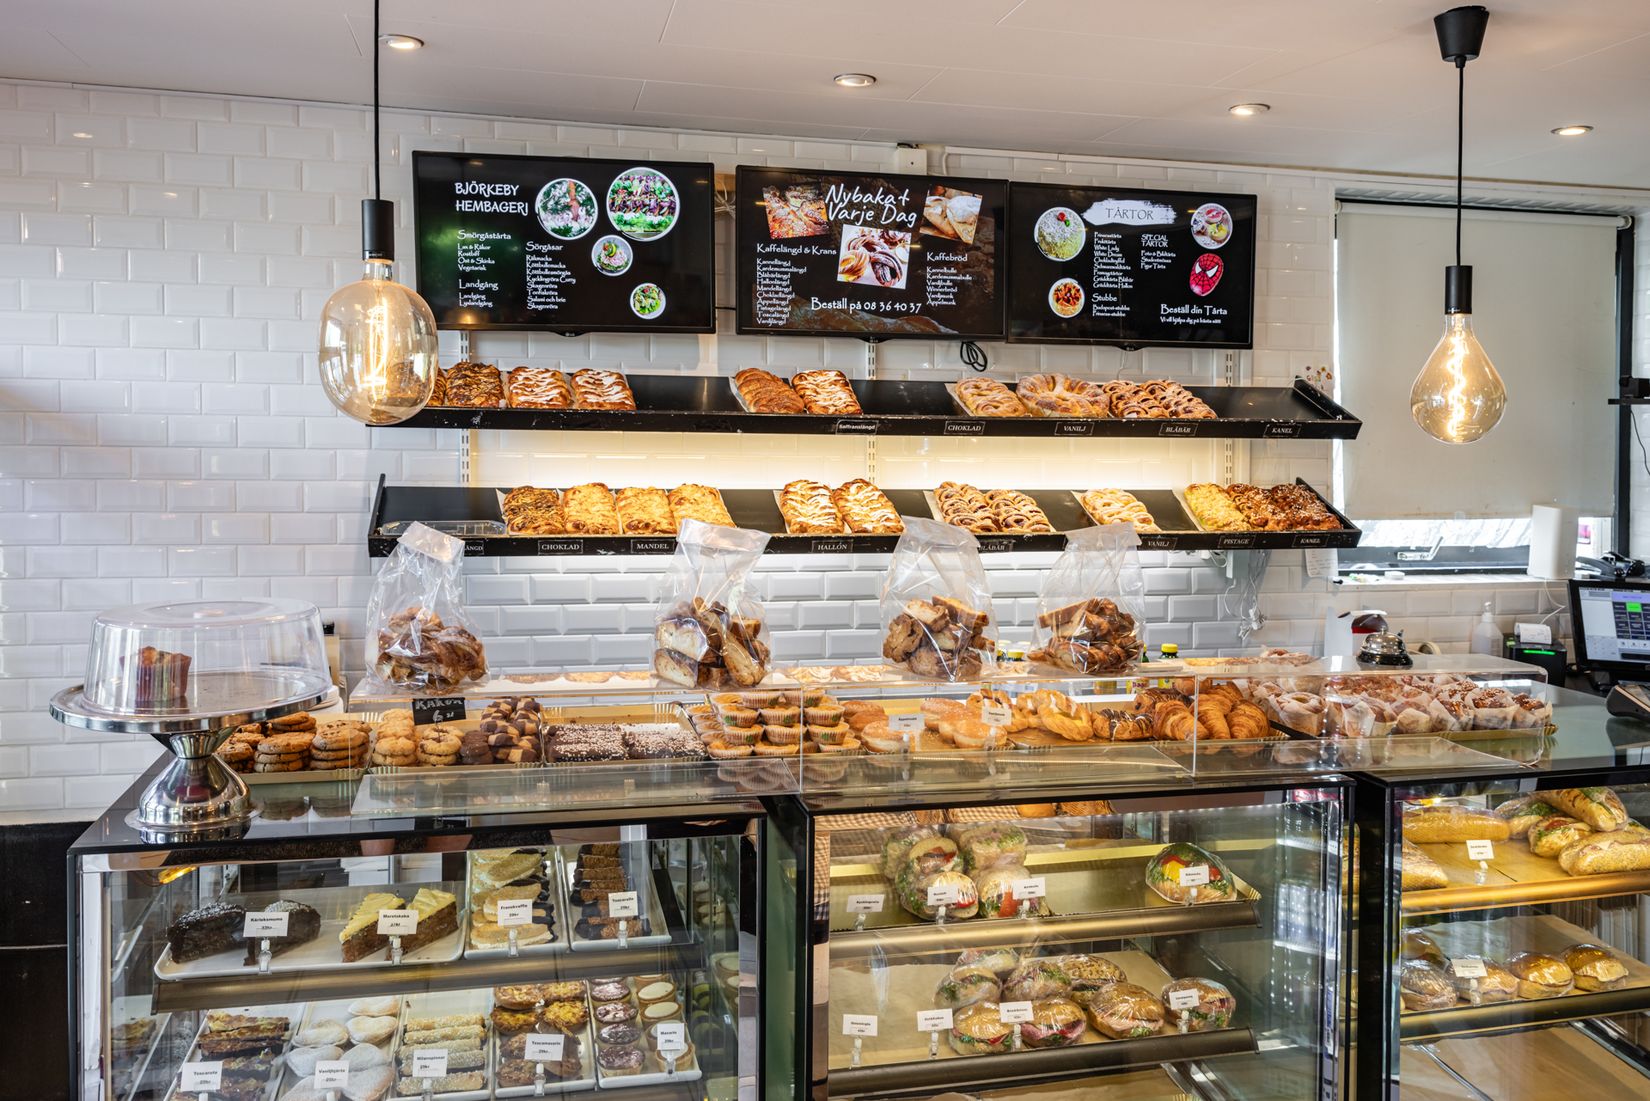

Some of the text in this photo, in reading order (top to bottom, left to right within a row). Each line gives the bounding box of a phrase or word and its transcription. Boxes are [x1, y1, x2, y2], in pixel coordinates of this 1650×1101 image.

[455, 181, 519, 197] BJÖRKEBY
[825, 183, 910, 207] Nybakat
[456, 200, 528, 216] HEMBAGERI
[828, 201, 917, 228] Varje Dag
[1105, 207, 1154, 220] TÅRTOR
[756, 243, 803, 255] Kaffelängd
[811, 245, 837, 255] Krans
[927, 252, 968, 262] Kaffebröd
[459, 279, 499, 290] Landgång
[1091, 293, 1118, 302] Stubbe
[811, 297, 922, 314] Beställ på 08 36 40 37
[1160, 303, 1228, 316] Beställ din Tårta
